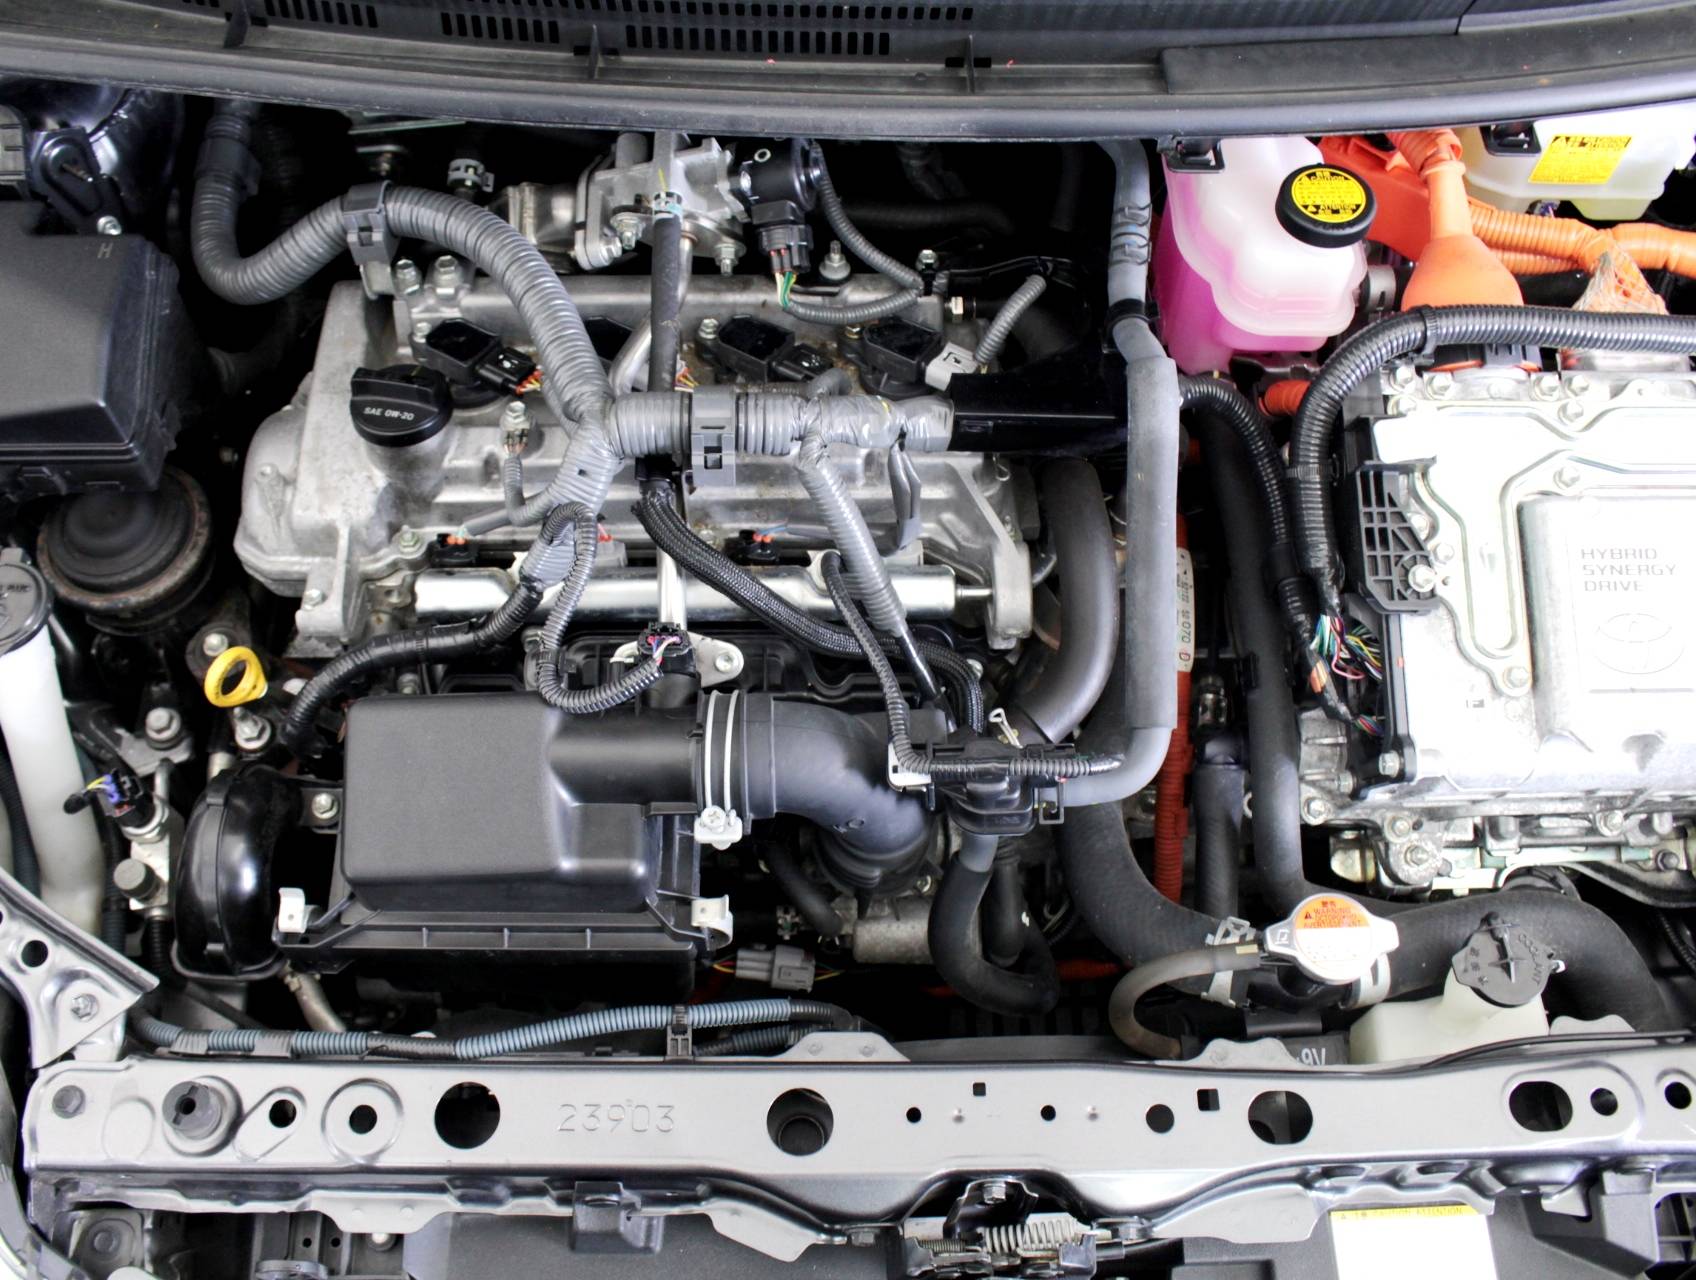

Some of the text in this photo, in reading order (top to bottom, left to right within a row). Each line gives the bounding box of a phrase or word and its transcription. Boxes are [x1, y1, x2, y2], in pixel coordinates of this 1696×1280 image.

[363, 407, 383, 416] SAE
[1581, 548, 1657, 560] HYBRID
[1582, 564, 1677, 576] SYNERGY
[1584, 580, 1645, 592] DRIVE
[557, 1103, 676, 1133] 23903
